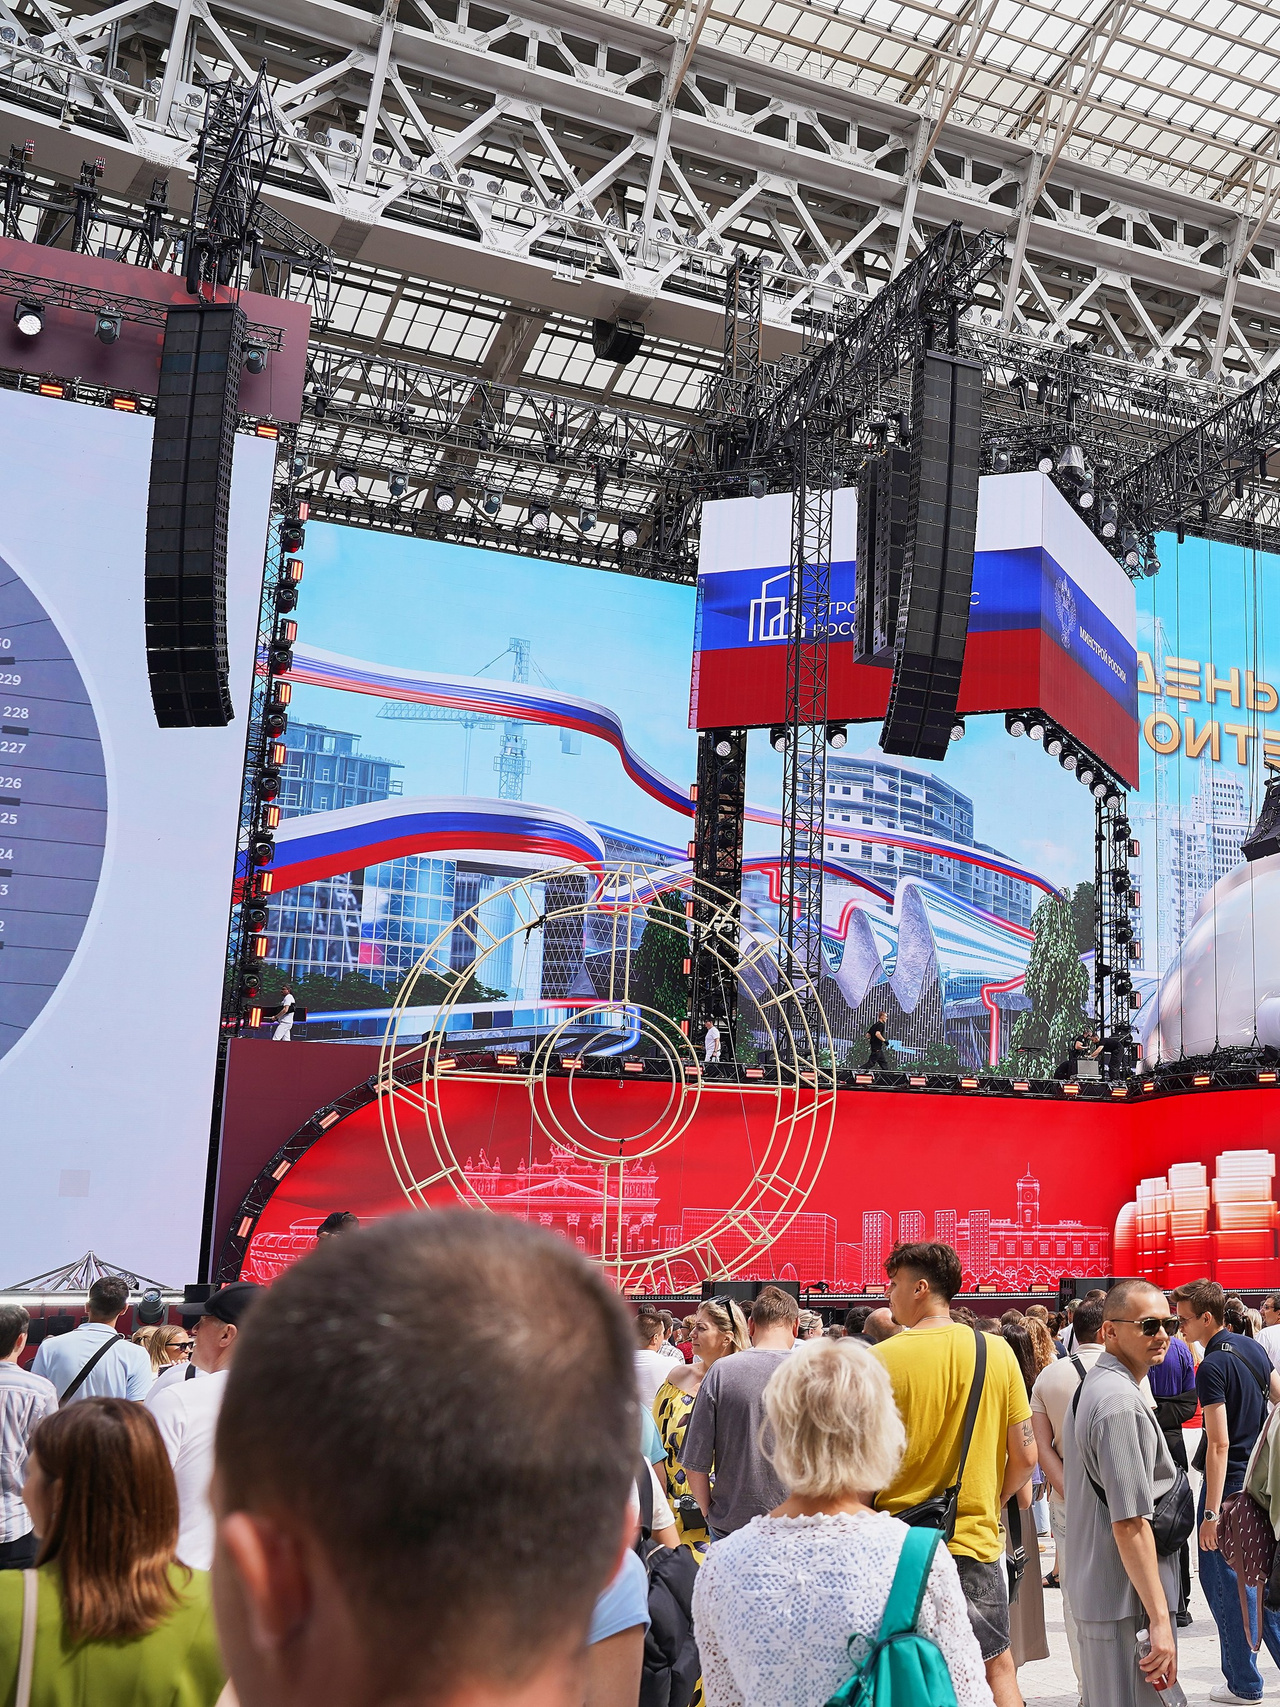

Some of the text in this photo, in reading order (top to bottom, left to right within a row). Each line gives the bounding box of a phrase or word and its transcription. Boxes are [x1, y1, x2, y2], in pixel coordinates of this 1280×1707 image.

[1079, 625, 1127, 684] МИНСТРОЙ РОССИИ
[1137, 651, 1279, 713] ДЕНЬ
[3, 706, 29, 719] 228
[0, 741, 26, 754] 227
[0, 812, 18, 825] 25
